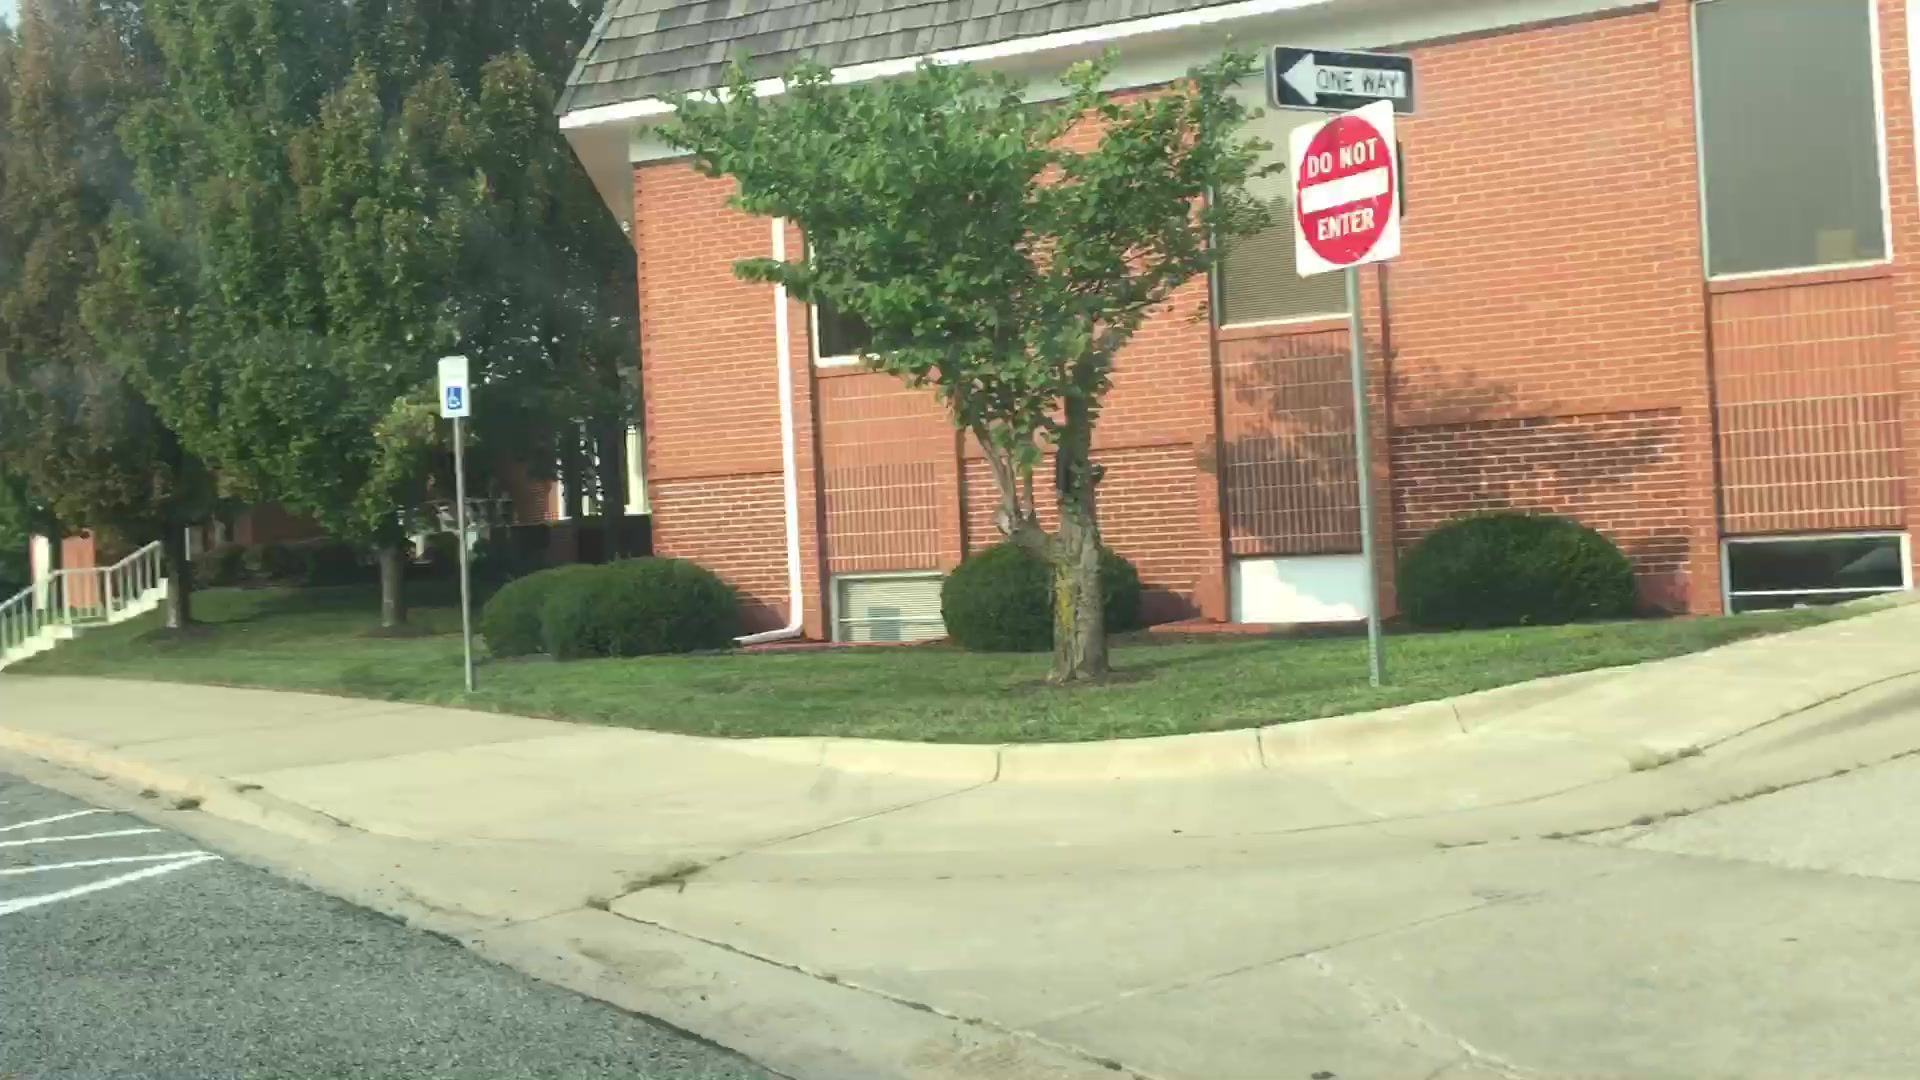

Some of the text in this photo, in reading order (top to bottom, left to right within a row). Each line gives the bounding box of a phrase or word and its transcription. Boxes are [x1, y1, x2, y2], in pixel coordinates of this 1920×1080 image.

[1317, 69, 1400, 96] ONE WAY
[1307, 138, 1378, 178] DO NOT
[1318, 208, 1375, 240] ENTER
